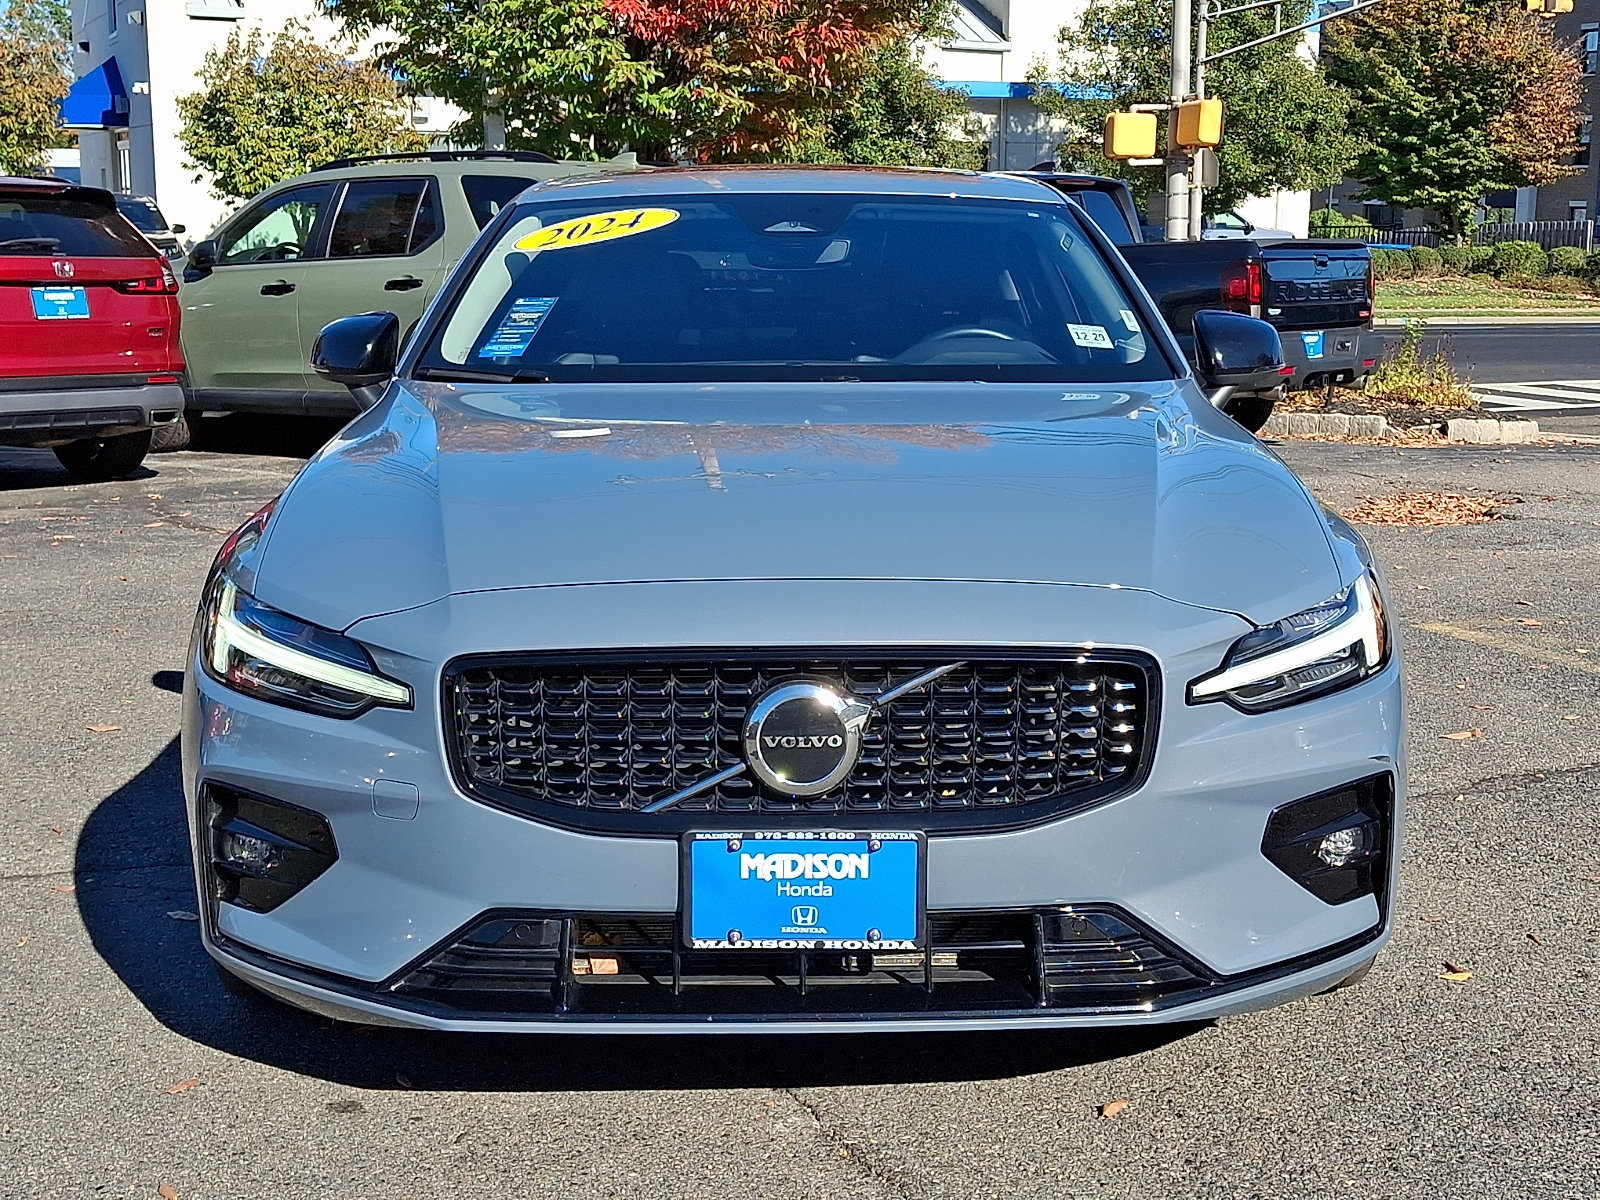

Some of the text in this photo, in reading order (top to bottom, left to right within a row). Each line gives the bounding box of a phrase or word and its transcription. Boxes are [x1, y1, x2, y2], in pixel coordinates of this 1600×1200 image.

[538, 211, 646, 248] 2024
[1074, 331, 1089, 341] 12
[762, 735, 843, 748] VOLVO
[695, 832, 743, 840] MADISON
[870, 832, 919, 840] HONDA
[740, 853, 869, 882] MADISON
[777, 881, 833, 897] Honda
[780, 926, 828, 934] HONDA
[692, 940, 918, 950] MADISON HONDA
